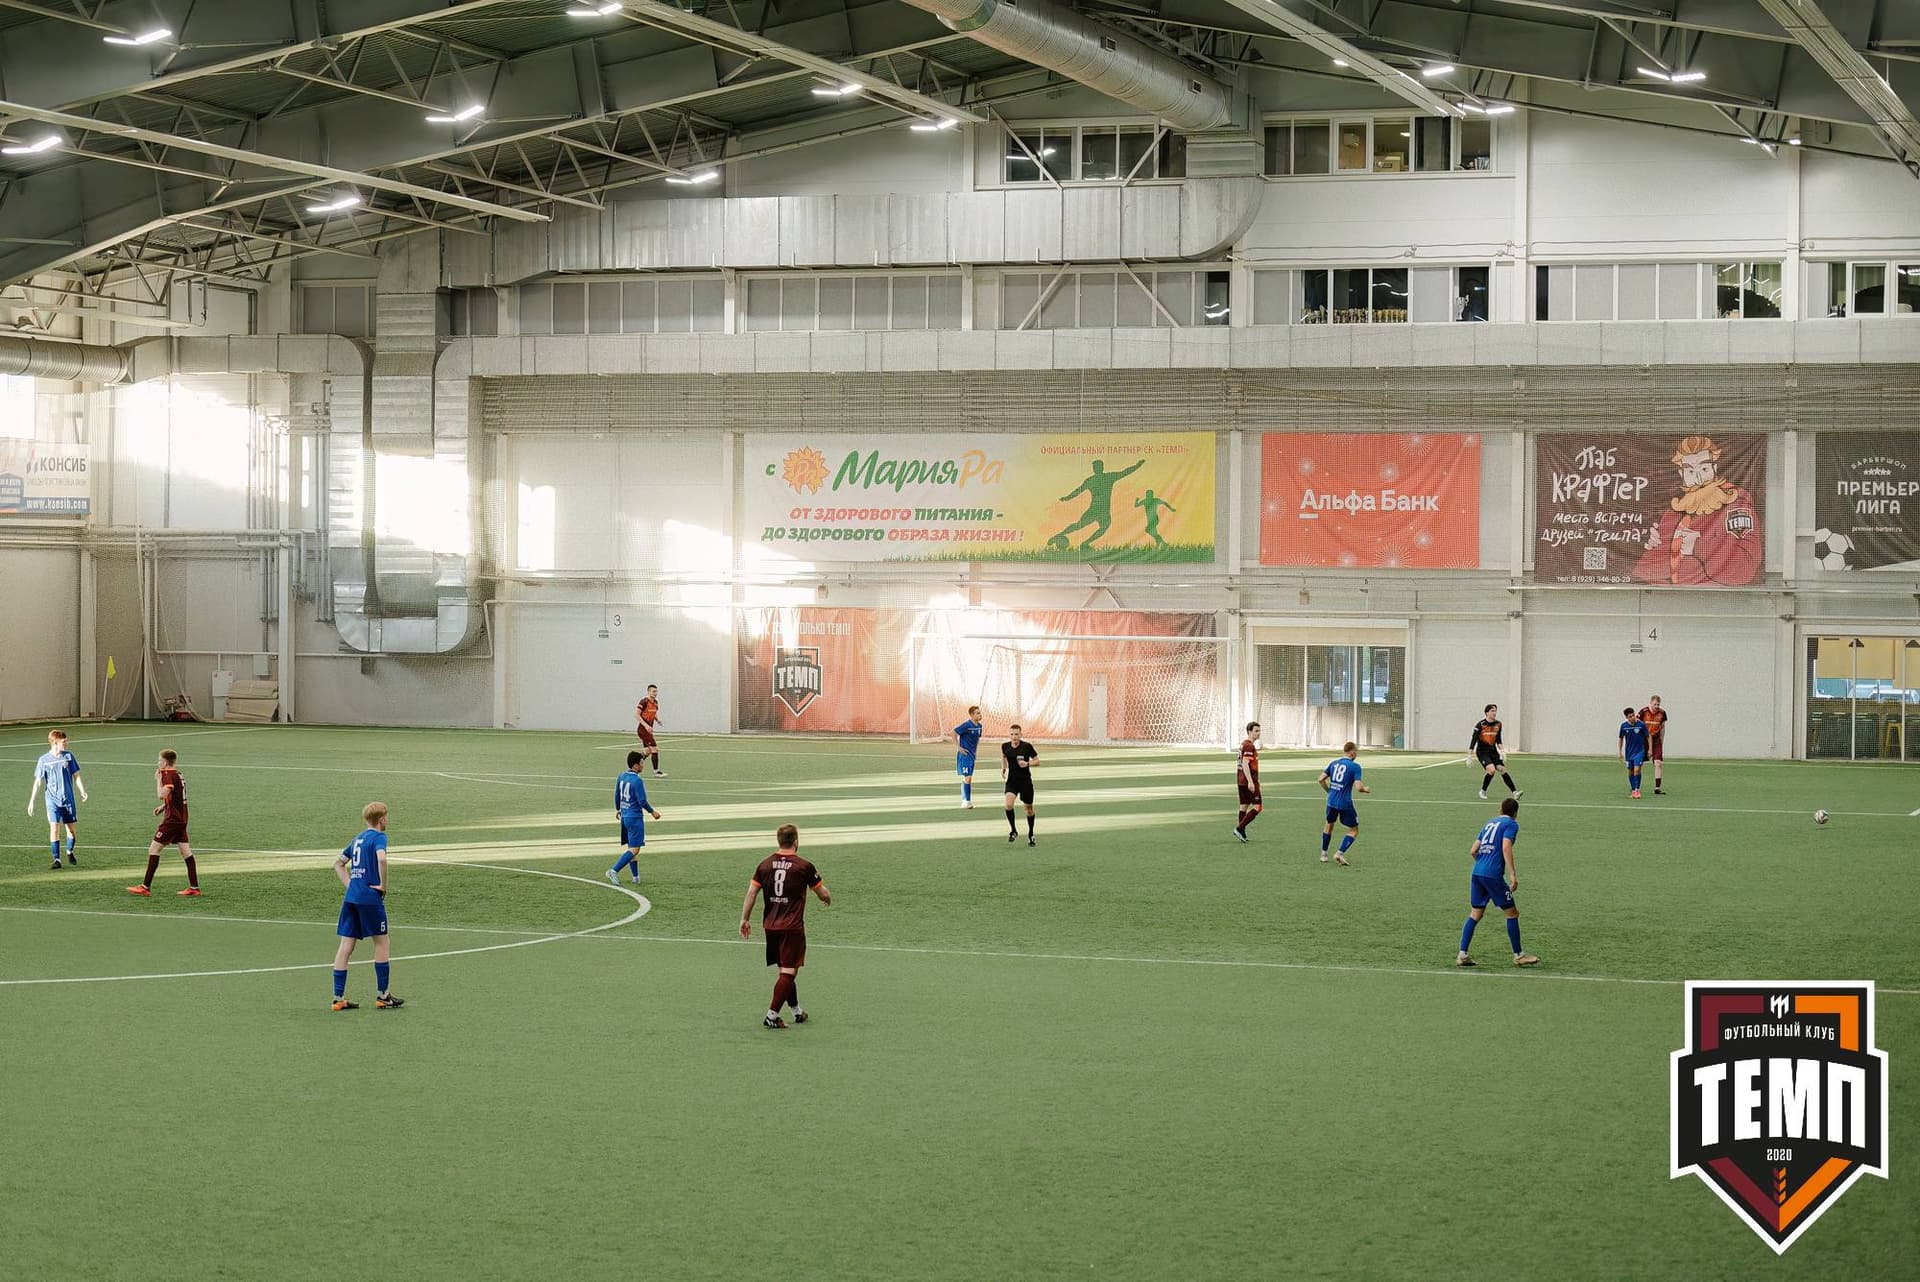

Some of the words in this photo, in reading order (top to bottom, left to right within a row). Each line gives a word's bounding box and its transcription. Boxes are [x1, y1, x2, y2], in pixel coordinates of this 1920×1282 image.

[1107, 445, 1140, 455] ПАРТНЕР
[40, 457, 86, 472] КОНСИБ
[1837, 481, 1920, 496] ПРЕМЬЕР
[1300, 489, 1376, 516] Альфа
[1381, 489, 1440, 512] Банк
[1856, 500, 1900, 514] ЛИГА
[790, 507, 811, 520] ОТ
[814, 507, 911, 522] ЗДОРОВОГО
[914, 508, 993, 521] ПИТАНИЯ
[761, 527, 785, 542] ДО
[788, 527, 884, 542] ЗДОРОВОГО
[887, 529, 950, 542] ОБРАЗА
[613, 614, 622, 627] 3
[796, 622, 825, 635] ОЛЬКО
[1648, 627, 1658, 641] 4
[777, 665, 819, 691] ТЕМП
[1332, 762, 1347, 783] 18
[619, 780, 631, 802] 14
[1481, 822, 1501, 845] 21
[352, 838, 364, 867] 5
[774, 869, 787, 897] 8
